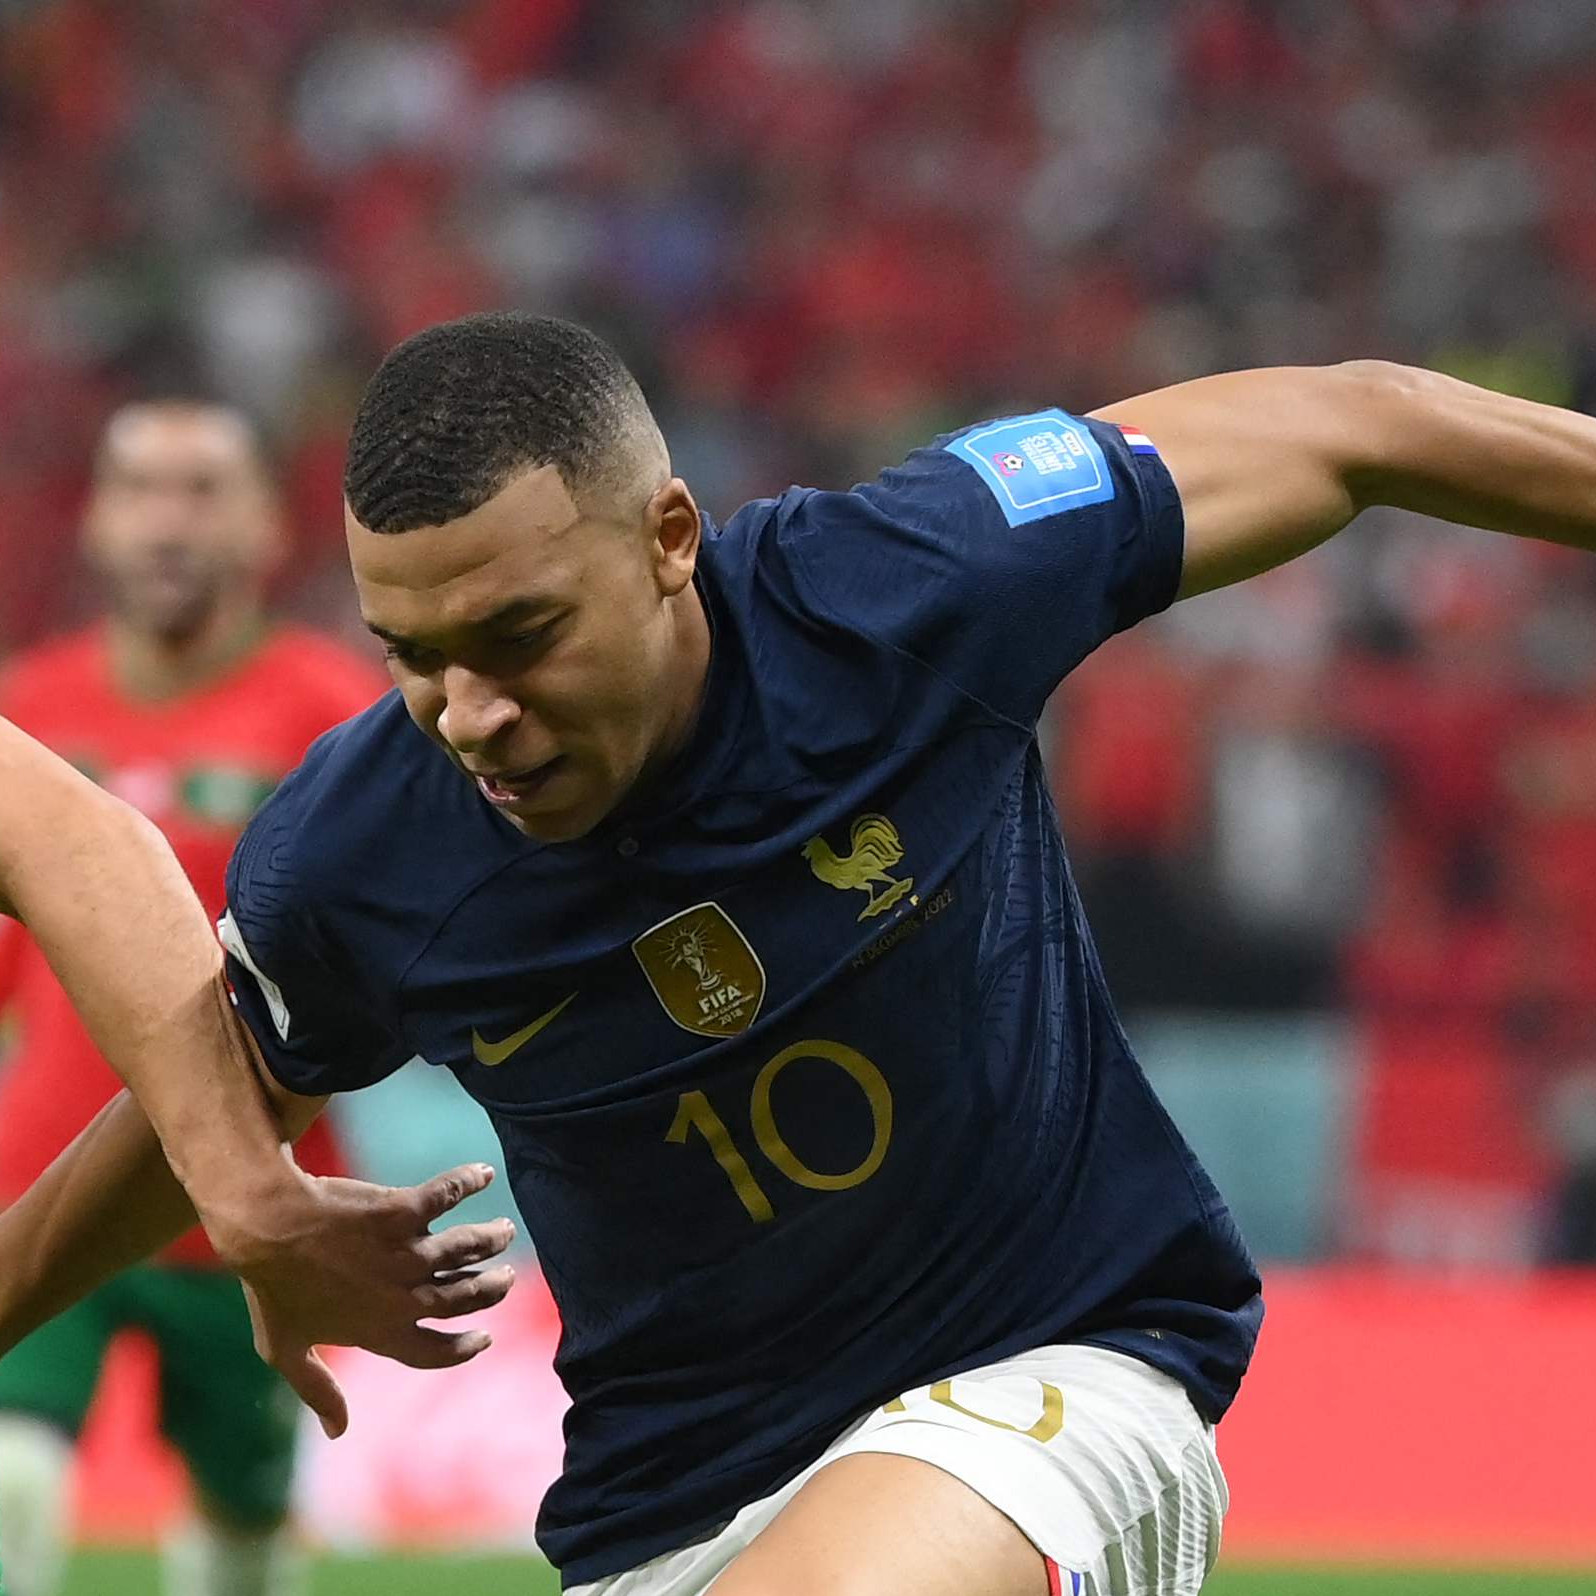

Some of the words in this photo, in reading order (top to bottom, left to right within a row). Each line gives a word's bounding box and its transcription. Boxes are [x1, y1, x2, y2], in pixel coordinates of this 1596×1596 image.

[698, 984, 742, 1014] FIFA
[718, 1008, 744, 1026] 2018
[664, 1039, 895, 1224] 10
[883, 1377, 1065, 1444] 0
